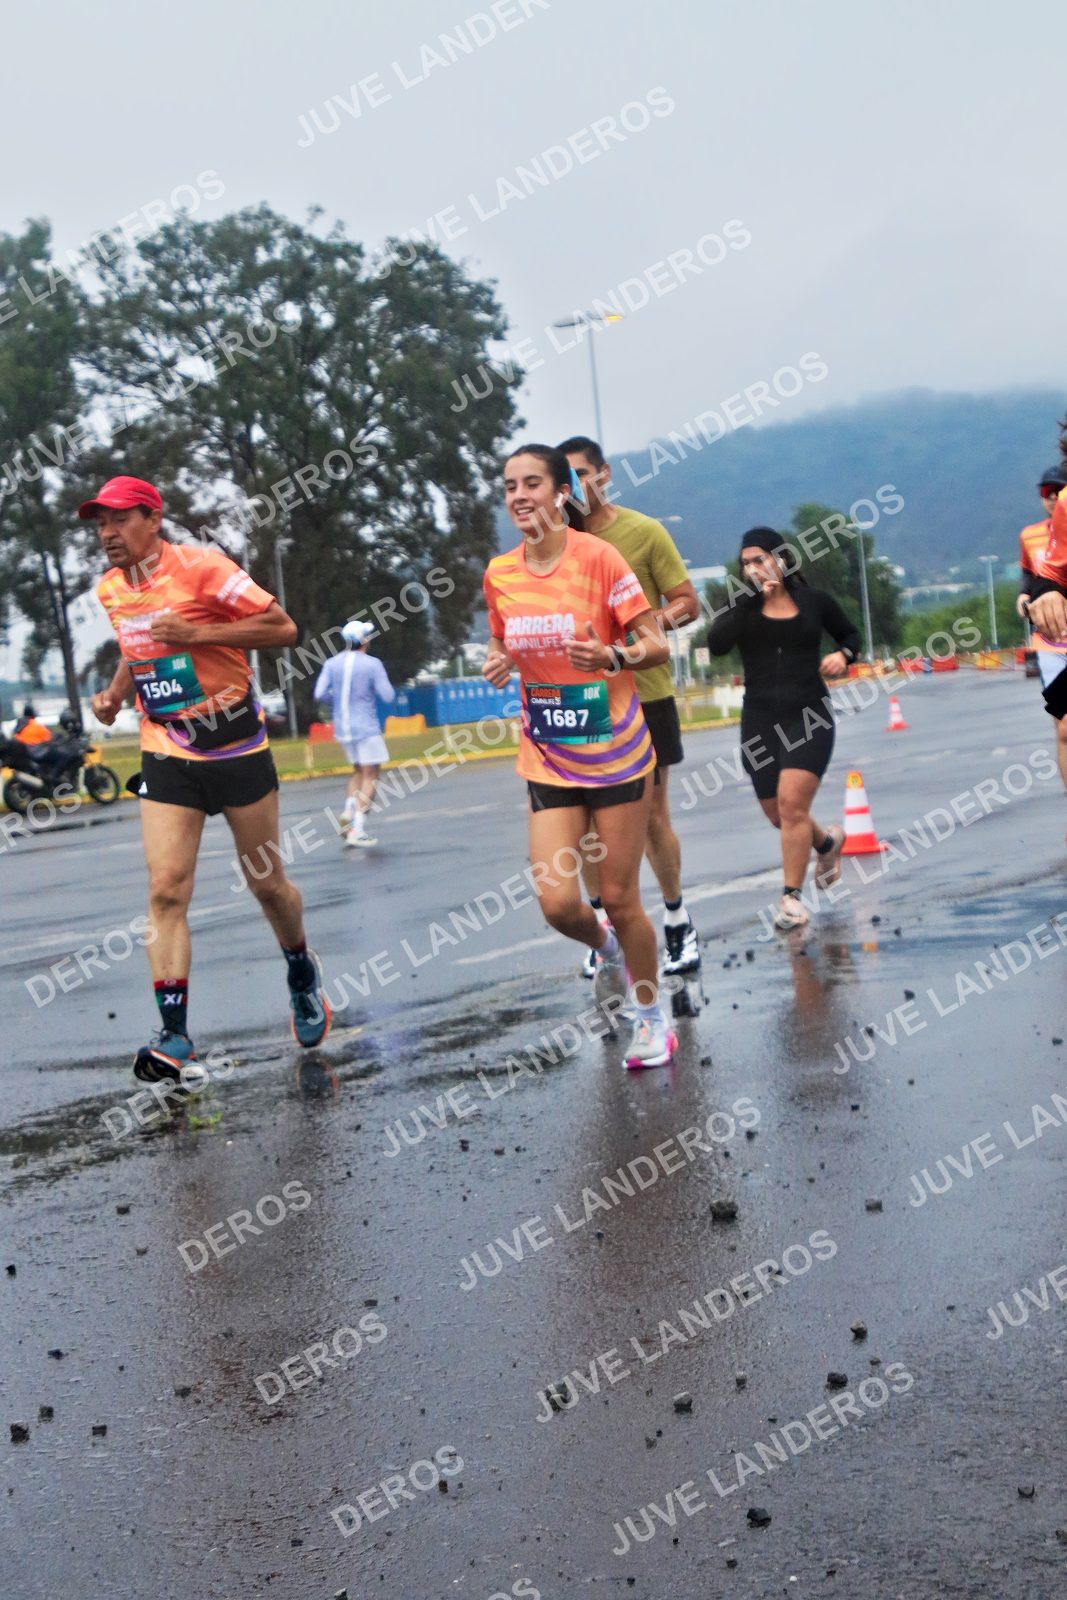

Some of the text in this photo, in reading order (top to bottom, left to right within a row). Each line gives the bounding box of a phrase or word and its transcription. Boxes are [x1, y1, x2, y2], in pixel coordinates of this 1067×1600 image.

[506, 613, 575, 635] CARRERA
[506, 636, 560, 650] OMNILIFE
[142, 679, 183, 699] 1504
[583, 687, 600, 700] 10K
[542, 709, 589, 727] 1687
